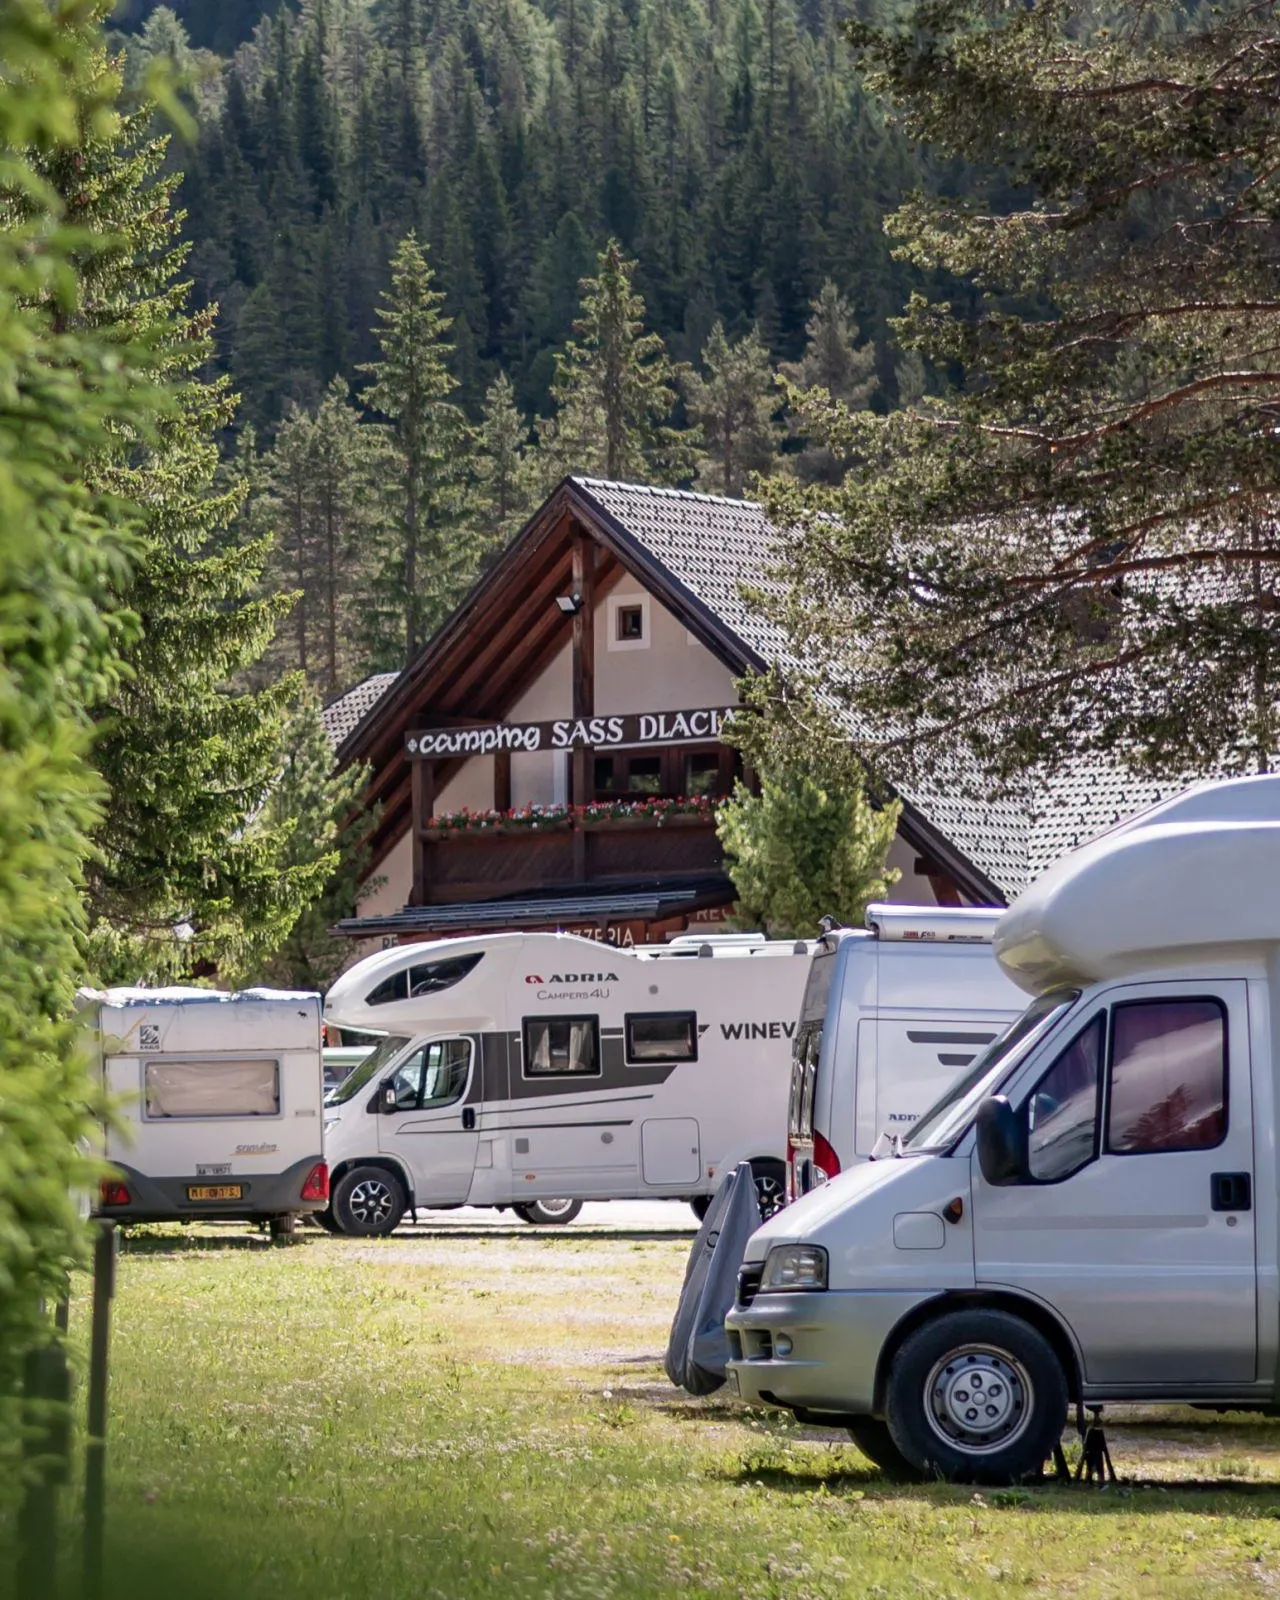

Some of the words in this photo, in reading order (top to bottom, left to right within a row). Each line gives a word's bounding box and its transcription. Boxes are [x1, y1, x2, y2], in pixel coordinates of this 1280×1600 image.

[419, 724, 541, 755] camping
[551, 717, 624, 747] SASS
[548, 973, 620, 984] ADRIA
[719, 1020, 797, 1041] WINEV
